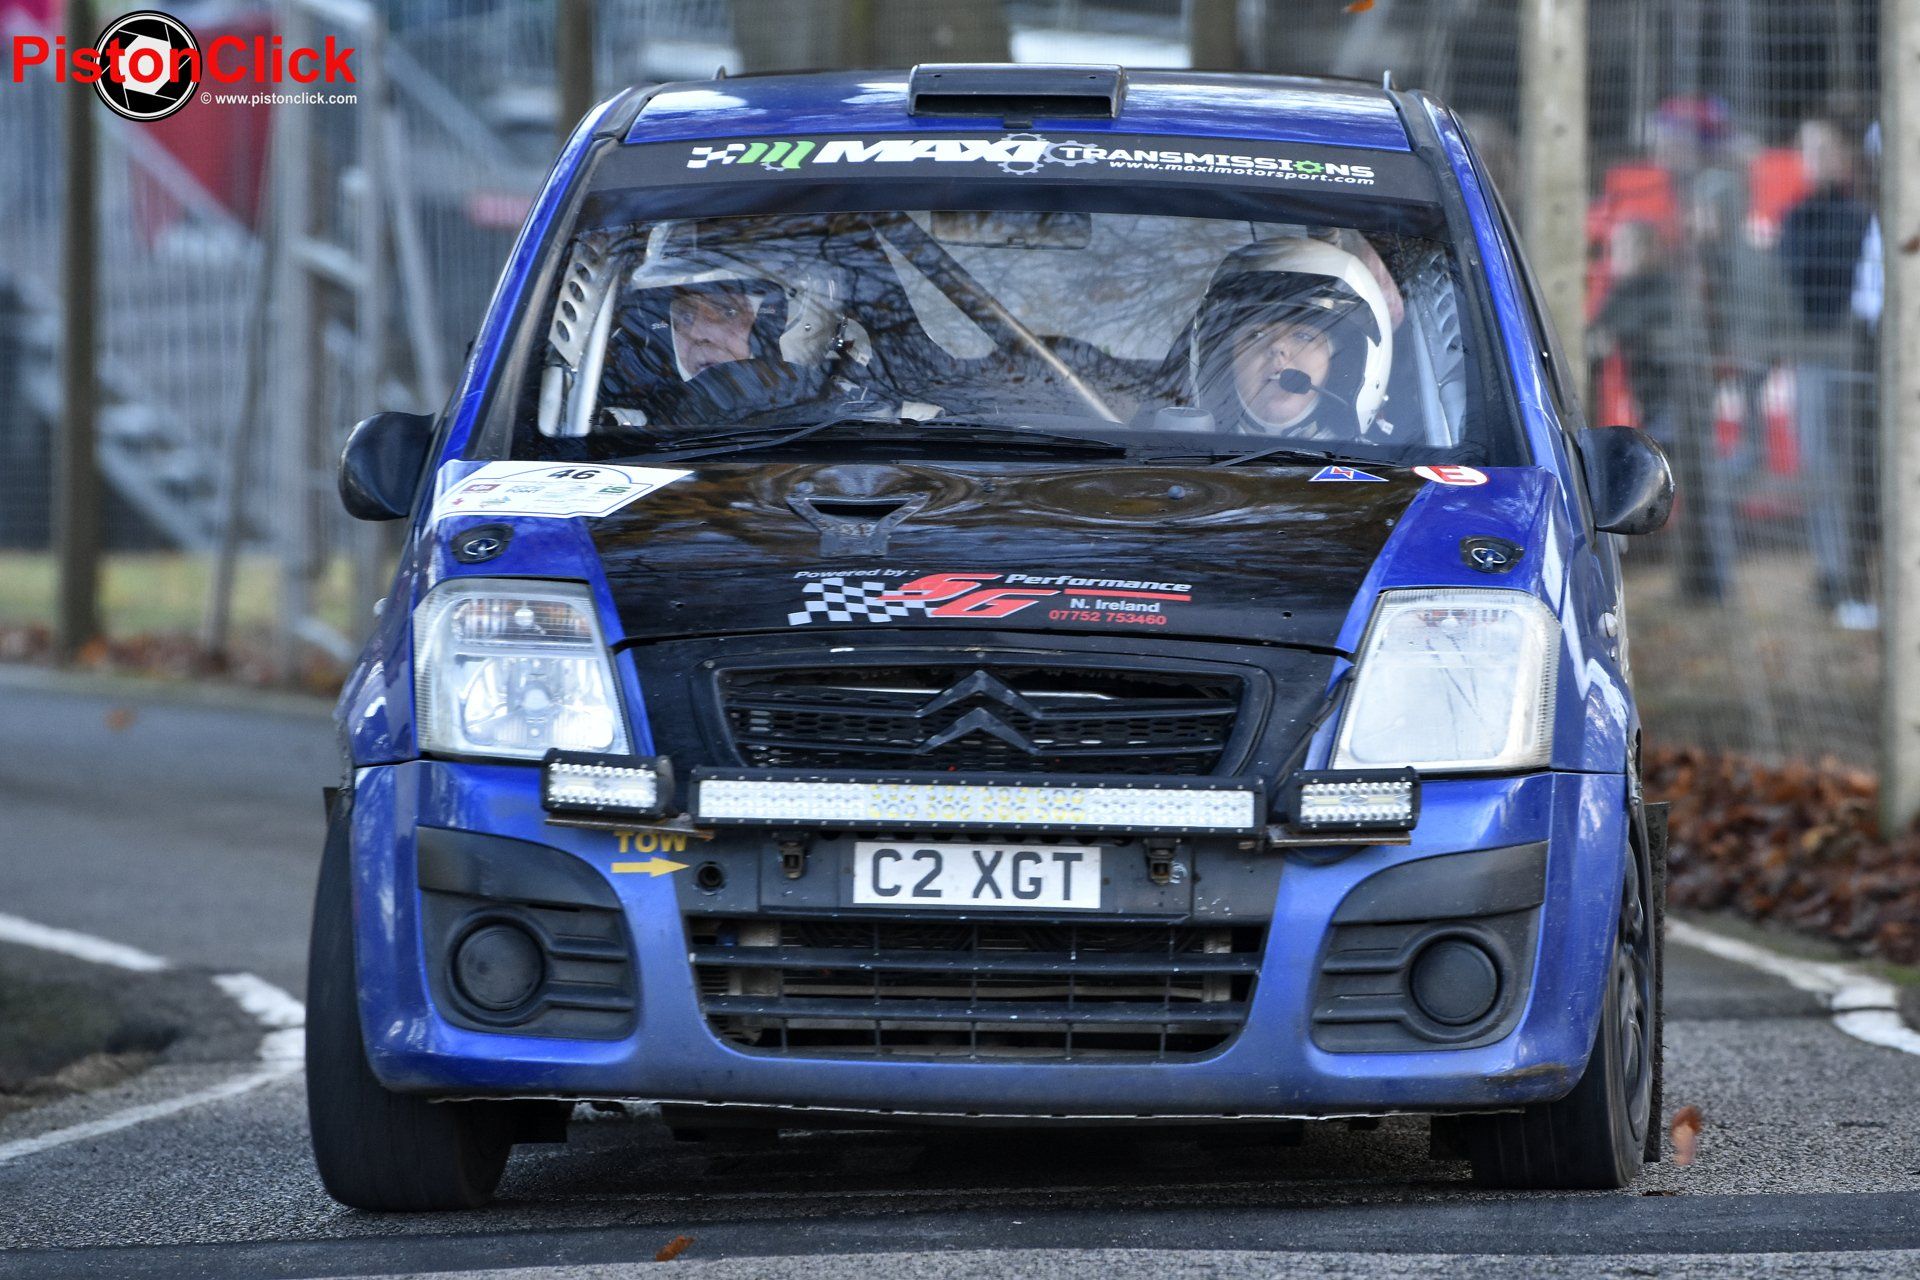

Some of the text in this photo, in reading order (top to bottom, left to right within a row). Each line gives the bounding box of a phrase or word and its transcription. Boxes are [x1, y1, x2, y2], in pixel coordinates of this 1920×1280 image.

[812, 140, 1050, 163] MAXI
[1109, 159, 1375, 185] www.maximotorsport.com
[547, 469, 600, 480] 46
[1429, 465, 1477, 483] E
[793, 569, 881, 579] Powered
[1005, 573, 1192, 592] Performance
[1069, 598, 1161, 613] N. Ireland
[1048, 610, 1168, 626] 07752 753460
[614, 831, 688, 853] TOW
[871, 848, 1083, 901] C2 XGT
